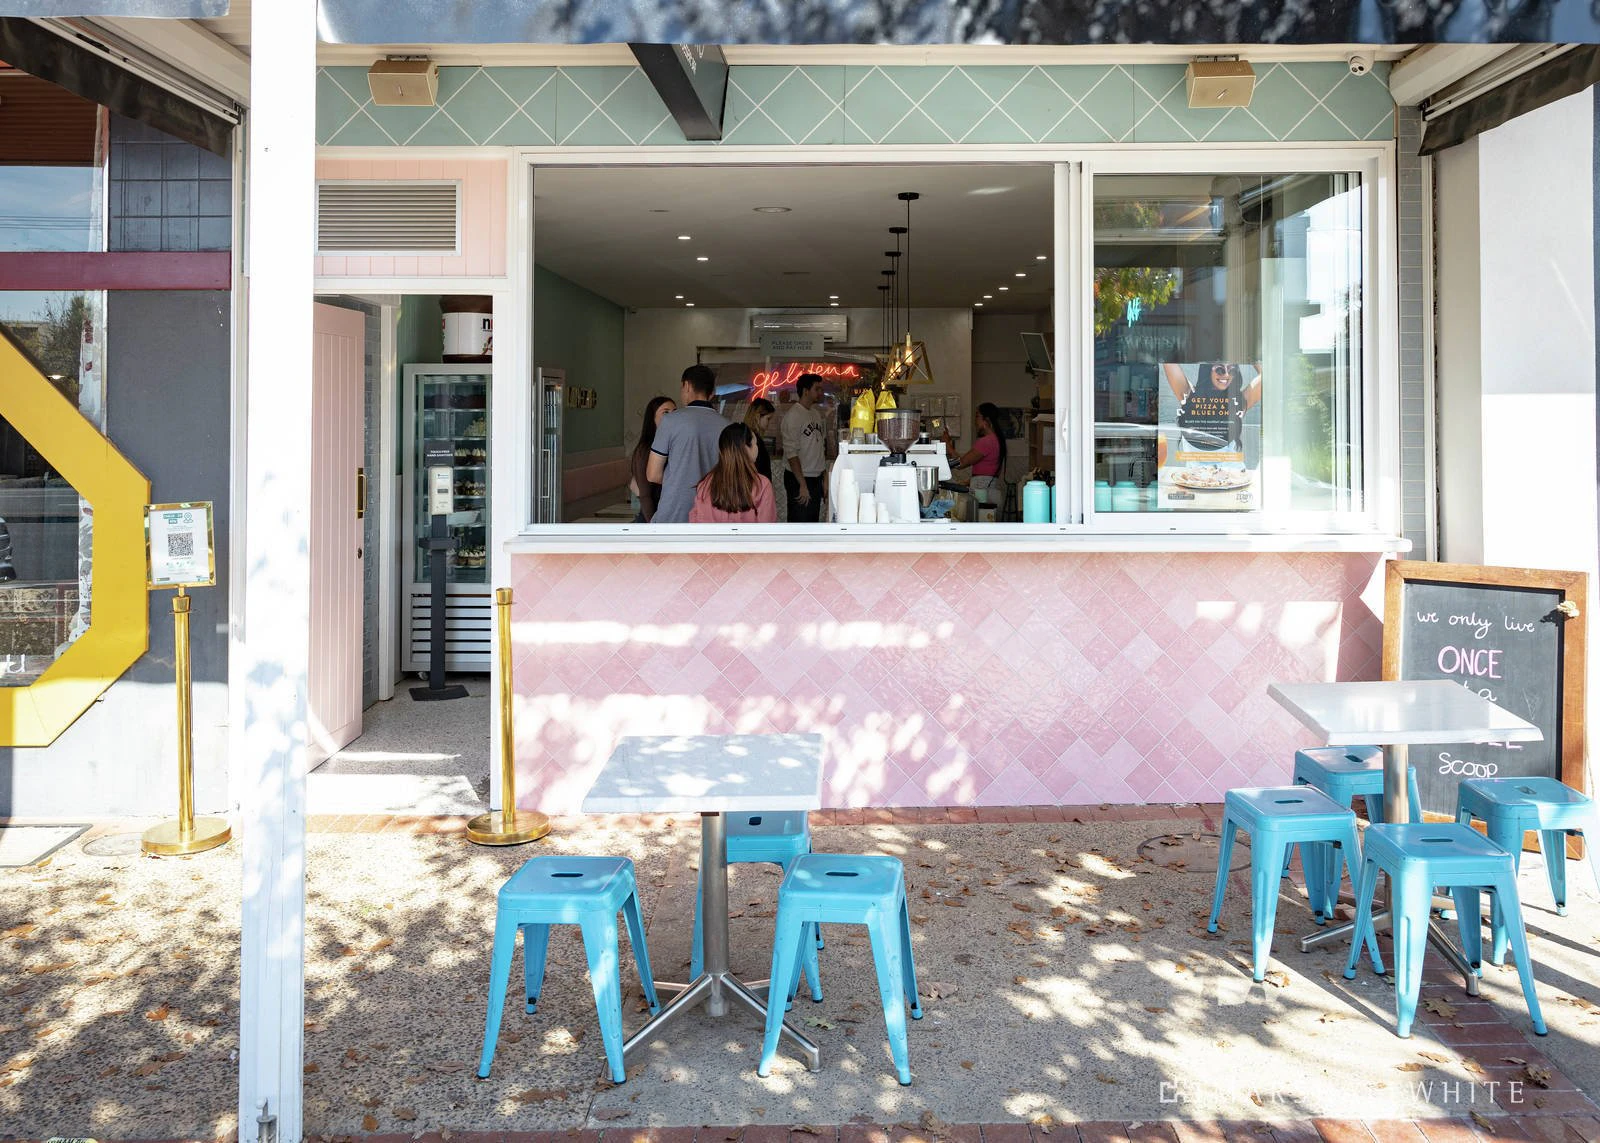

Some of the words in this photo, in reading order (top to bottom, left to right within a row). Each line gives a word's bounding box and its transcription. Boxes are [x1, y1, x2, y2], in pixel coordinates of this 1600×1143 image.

[1416, 611, 1439, 623] we
[1448, 611, 1492, 639] only
[1504, 615, 1535, 633] live
[1437, 645, 1504, 679] ONCE
